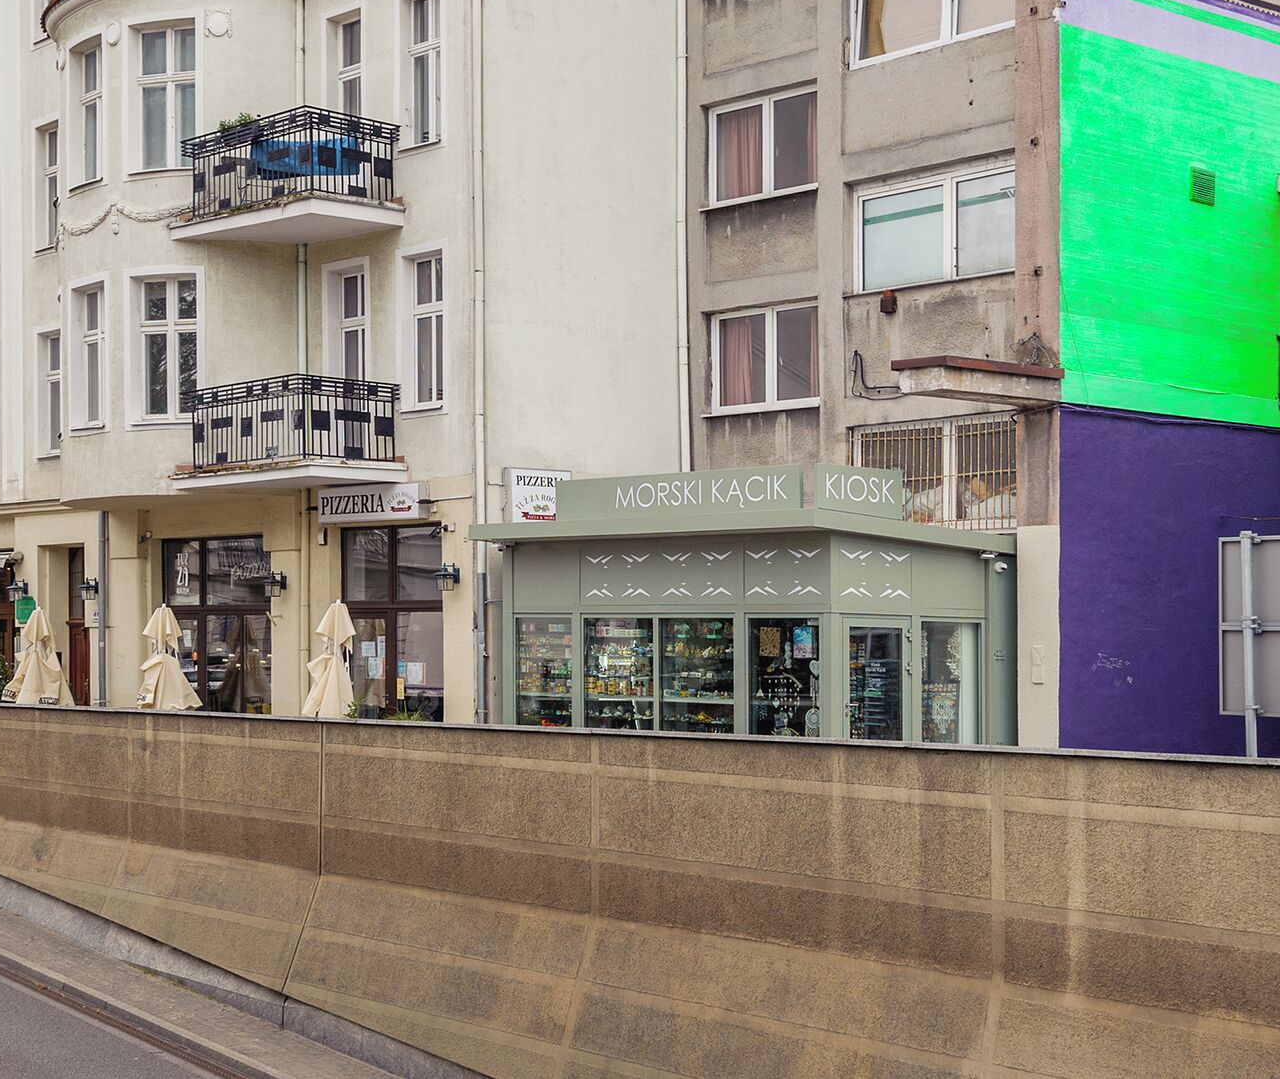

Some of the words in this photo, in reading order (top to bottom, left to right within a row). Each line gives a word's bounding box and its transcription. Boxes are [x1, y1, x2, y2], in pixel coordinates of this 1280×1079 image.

[516, 475, 563, 488] PIZZER
[615, 480, 702, 509] MORSKI
[711, 474, 788, 508] KĄCIK
[825, 473, 896, 505] KIOSK
[320, 493, 386, 516] PIZZERIA
[177, 567, 189, 587] ZA
